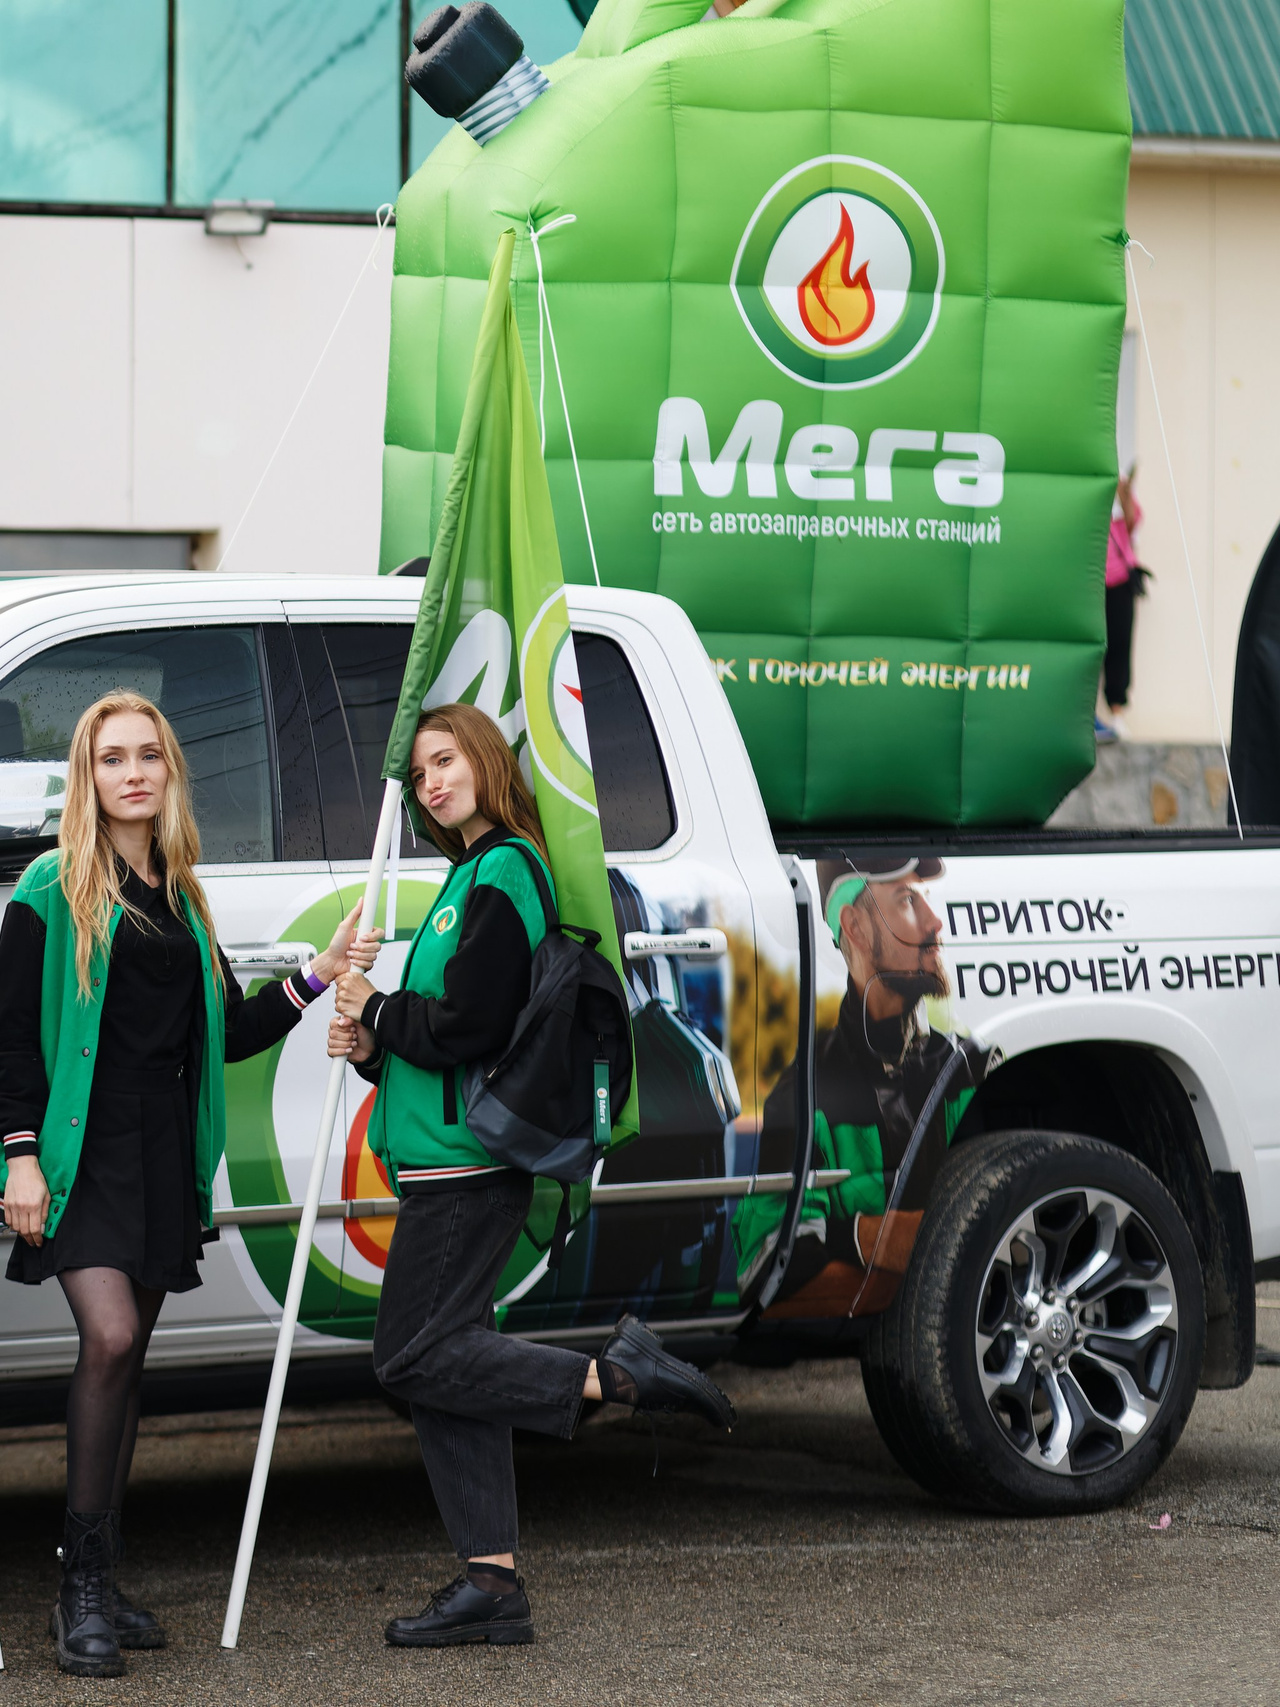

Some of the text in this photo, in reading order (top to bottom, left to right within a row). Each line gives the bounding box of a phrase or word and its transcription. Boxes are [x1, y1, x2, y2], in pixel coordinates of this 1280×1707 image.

[653, 396, 1006, 507] Мега
[652, 510, 1001, 547] сеть автозаправочных станций
[748, 657, 889, 687] ГОРЮЧЕЙ
[901, 661, 1031, 691] ЭНЕРГИИ
[955, 942, 1151, 999] ГОРЮЧЕЙ
